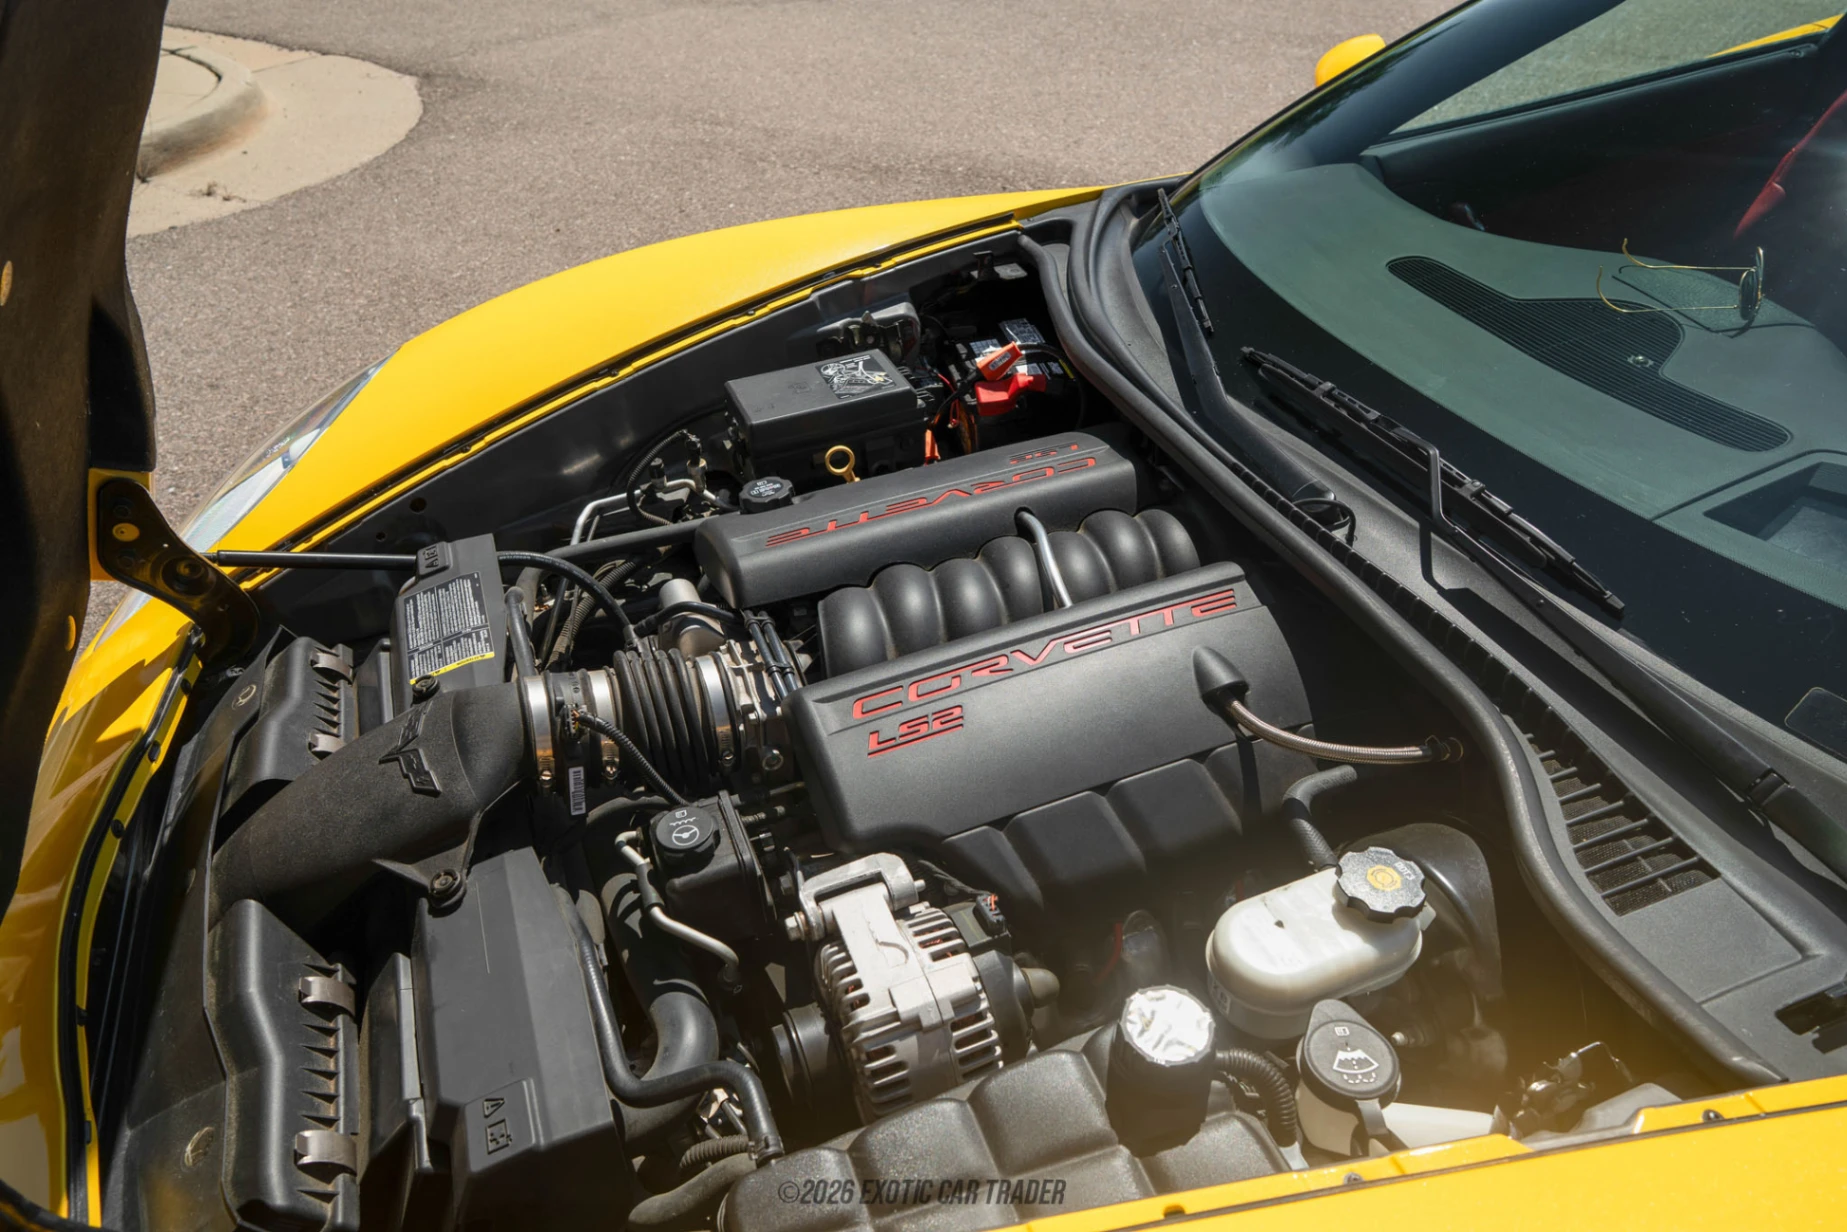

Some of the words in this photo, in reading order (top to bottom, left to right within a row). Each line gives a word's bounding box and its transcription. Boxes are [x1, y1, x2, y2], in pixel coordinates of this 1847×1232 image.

[765, 456, 1097, 547] CORVETTE
[851, 588, 1237, 720] CORVETTE
[868, 704, 964, 754] LS2
